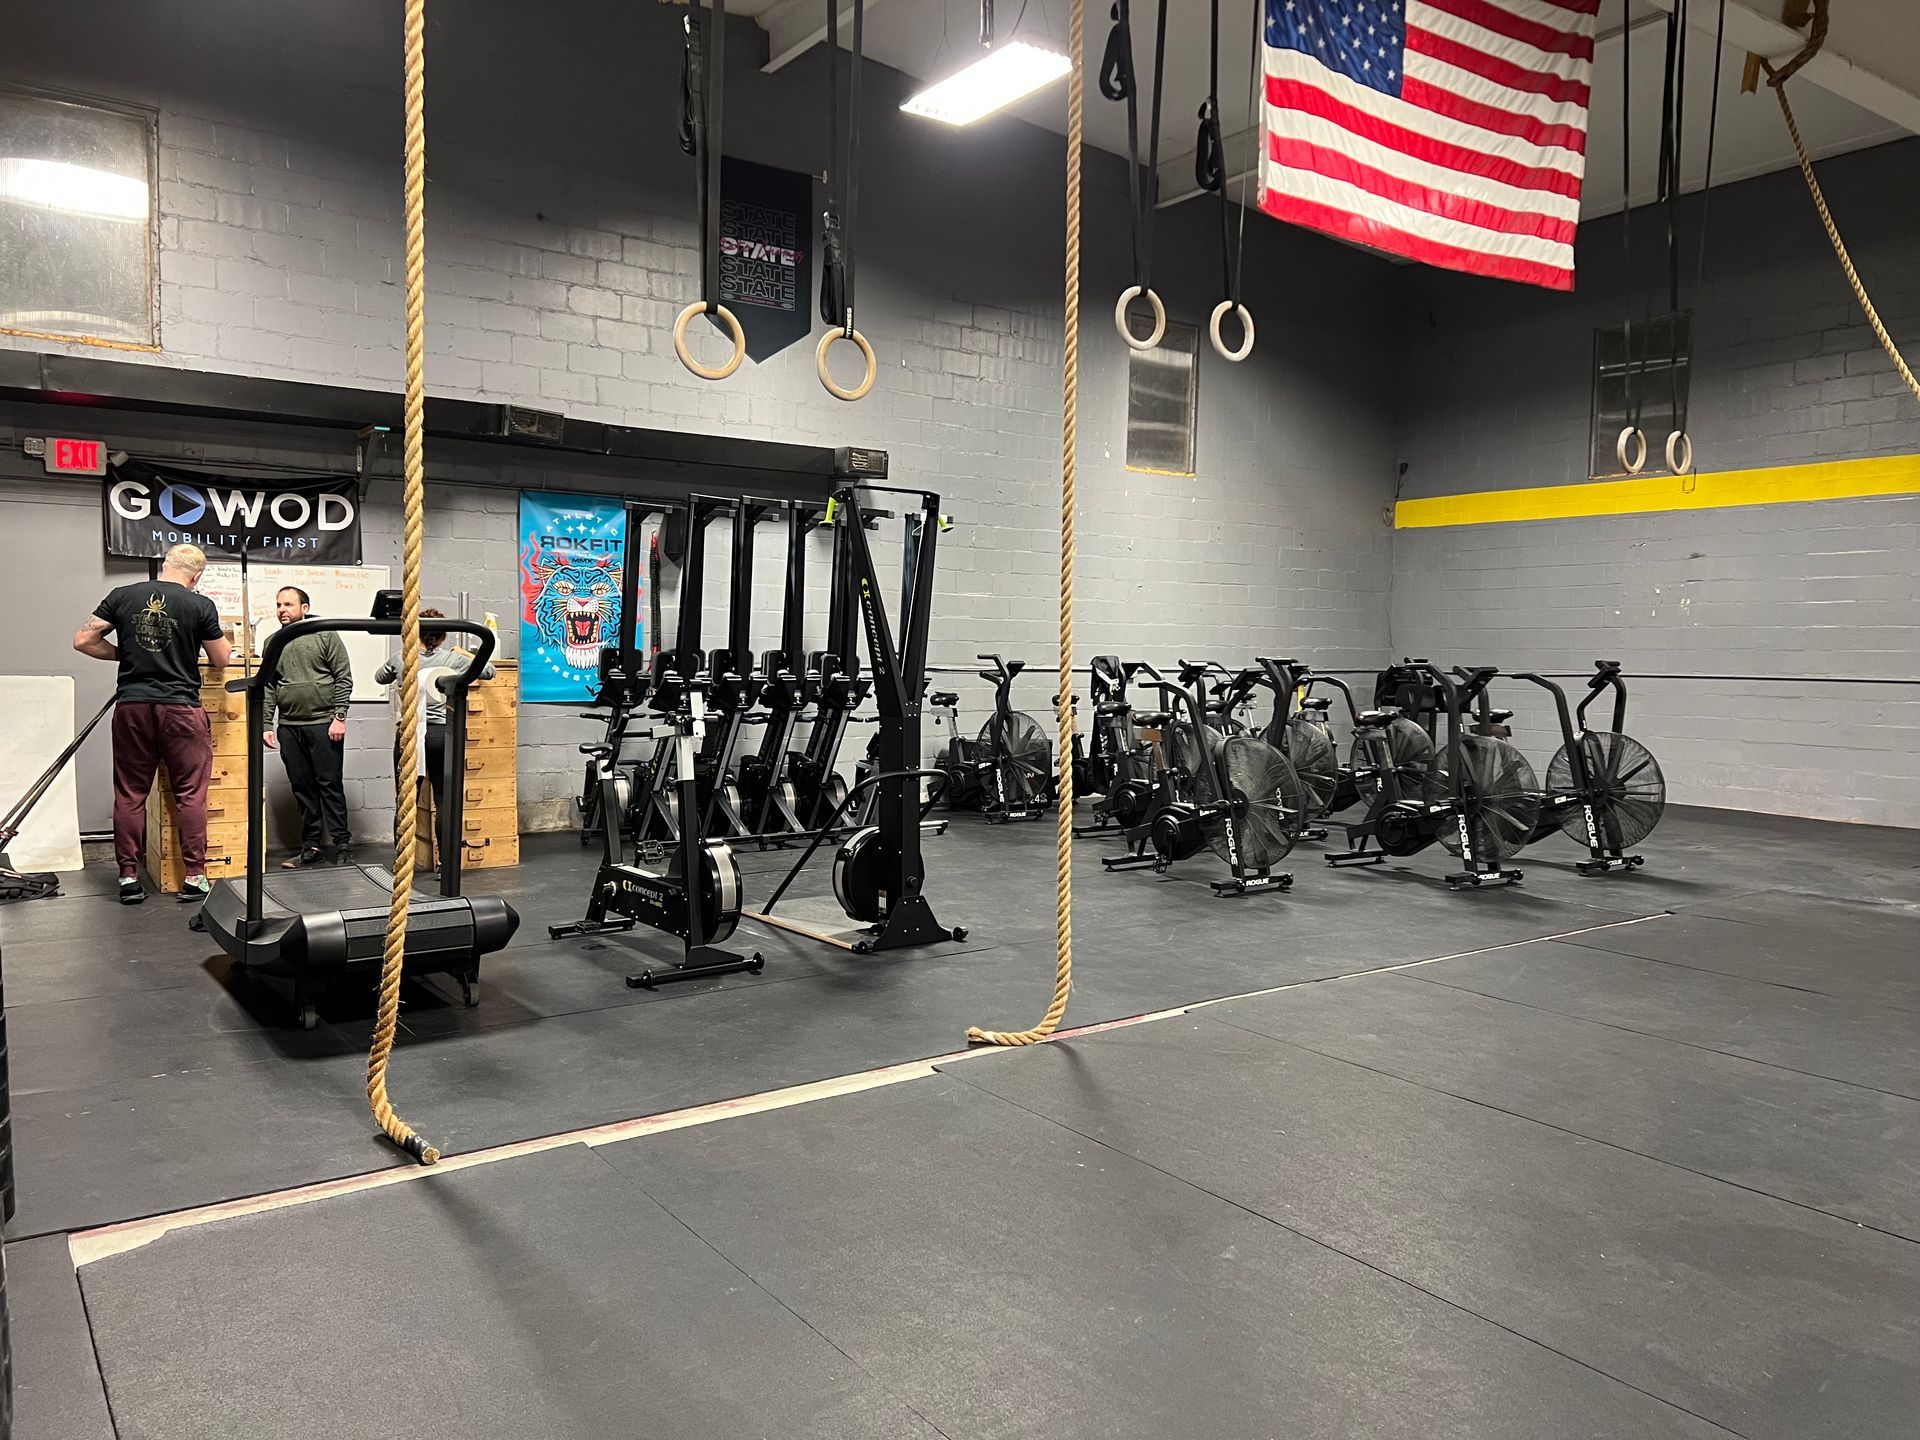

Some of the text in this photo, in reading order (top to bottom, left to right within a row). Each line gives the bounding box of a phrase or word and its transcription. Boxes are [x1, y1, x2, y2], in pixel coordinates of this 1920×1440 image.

[720, 199, 796, 230] STATE
[720, 218, 796, 249] STATE
[720, 237, 796, 267] STATE
[720, 254, 796, 285] STATE
[720, 272, 796, 303] STATE
[55, 439, 98, 471] EXIT
[545, 512, 618, 537] ATHLETIC
[263, 536, 319, 549] FIRST
[866, 600, 884, 663] concept
[1224, 818, 1239, 866] ROGUE
[1457, 814, 1472, 862] ROGUE
[1583, 804, 1599, 849] ROGUE
[632, 884, 664, 902] concept 2
[1245, 877, 1270, 887] ROGUE
